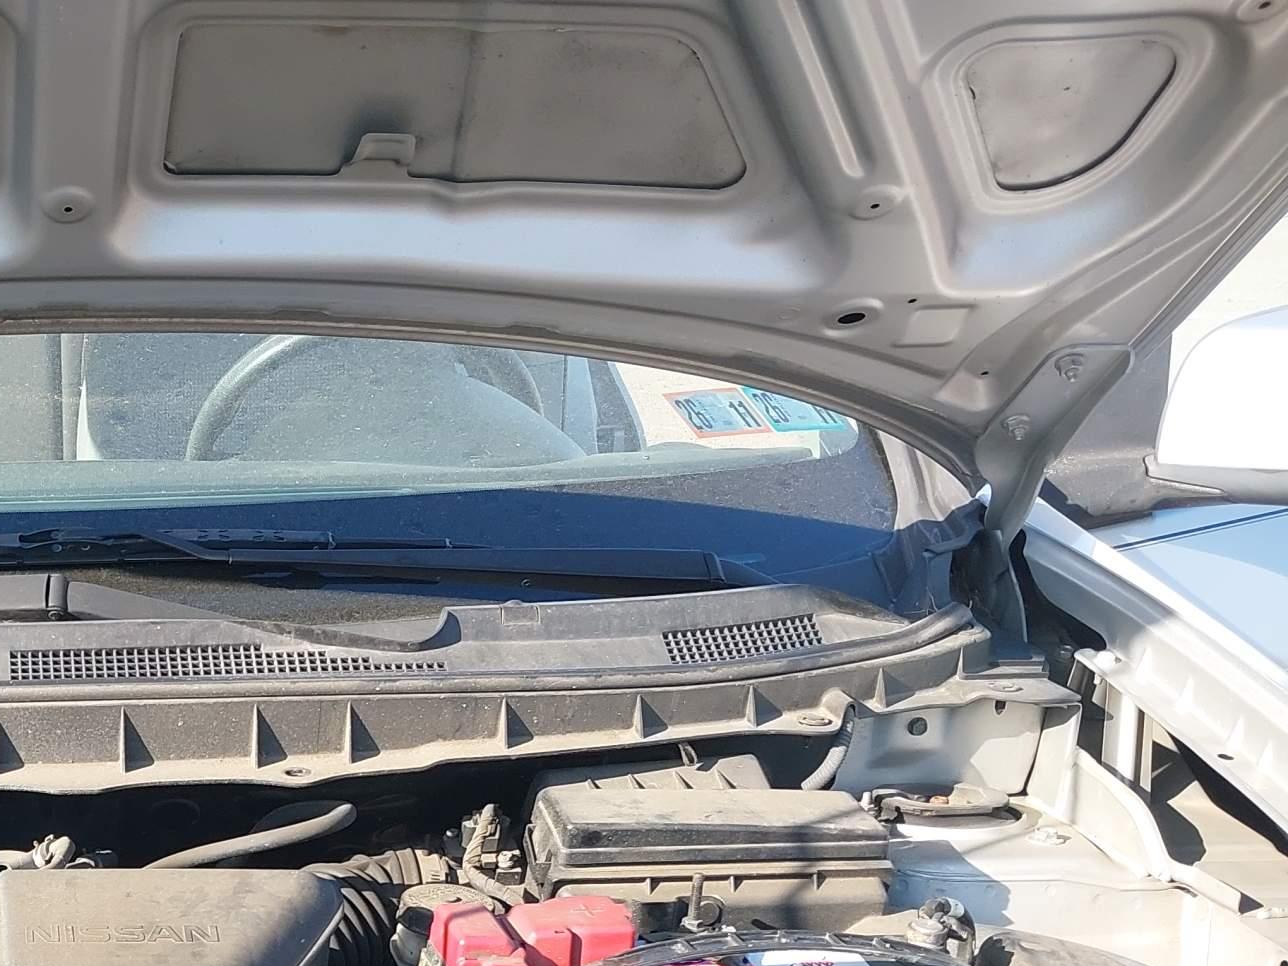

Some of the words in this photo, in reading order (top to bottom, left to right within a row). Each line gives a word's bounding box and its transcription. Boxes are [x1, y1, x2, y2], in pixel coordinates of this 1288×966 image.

[674, 399, 713, 431] 26
[728, 401, 761, 427] 11
[752, 393, 790, 423] 26
[24, 924, 220, 944] NISSAN
